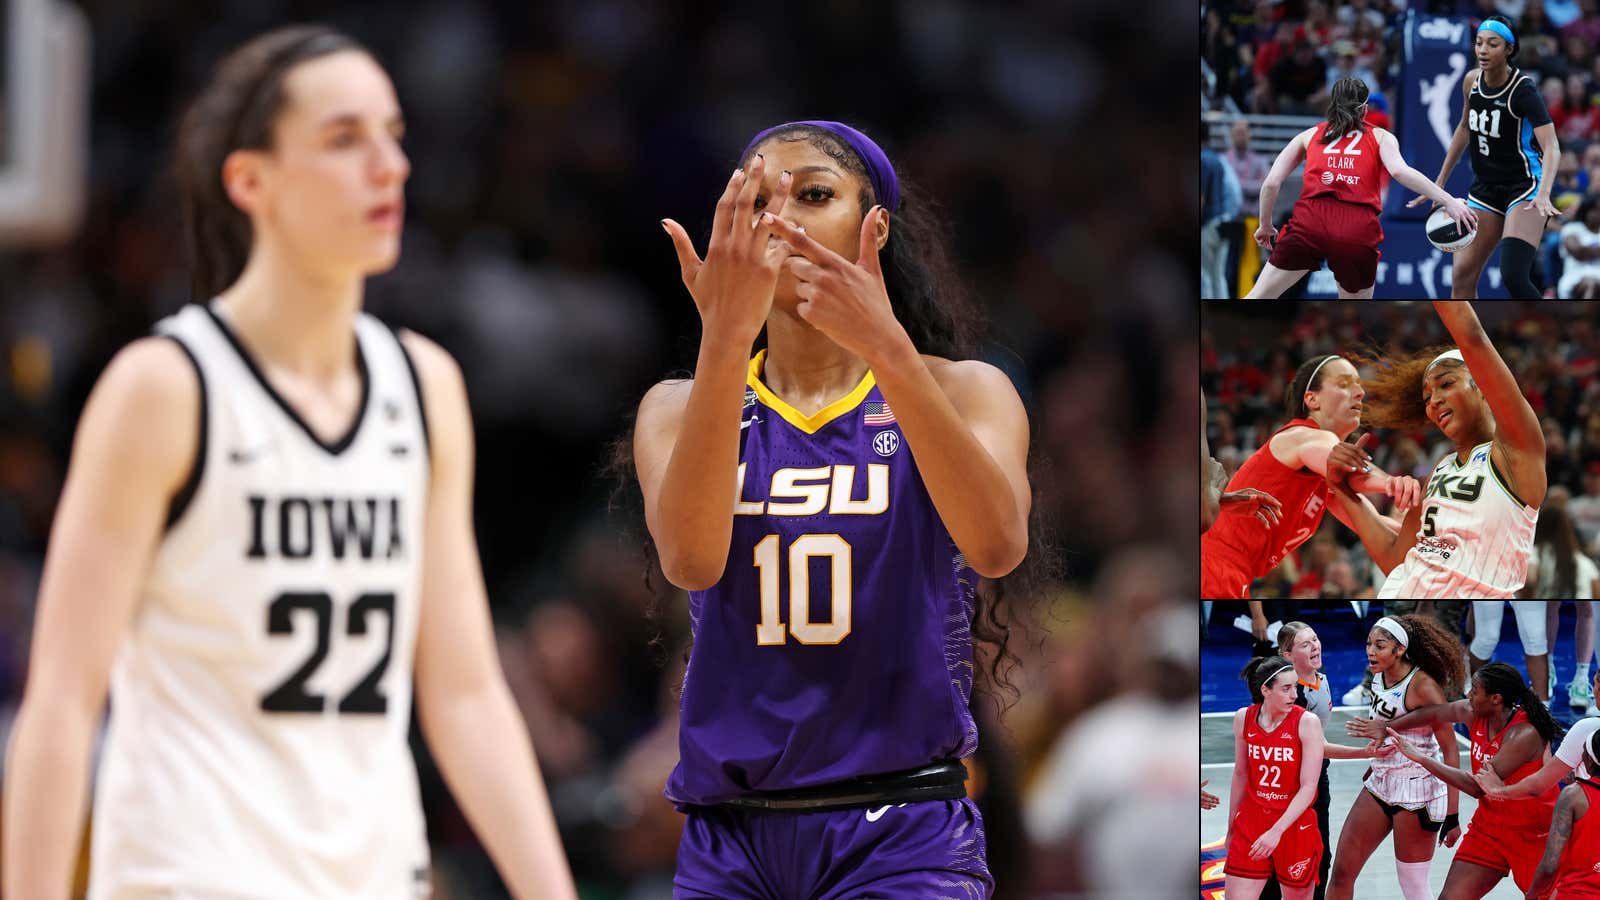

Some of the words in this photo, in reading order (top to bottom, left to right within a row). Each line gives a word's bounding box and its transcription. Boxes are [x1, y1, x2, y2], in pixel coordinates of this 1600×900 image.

[1478, 135, 1489, 156] 5
[1327, 156, 1354, 169] CLARK
[1336, 173, 1360, 185] AT&T
[875, 434, 897, 454] SEC
[733, 462, 890, 516] LSU
[1423, 506, 1438, 536] 5
[753, 533, 852, 646] 10
[261, 592, 396, 713] 22
[1248, 744, 1295, 761] FEVER
[1259, 765, 1281, 788] 22
